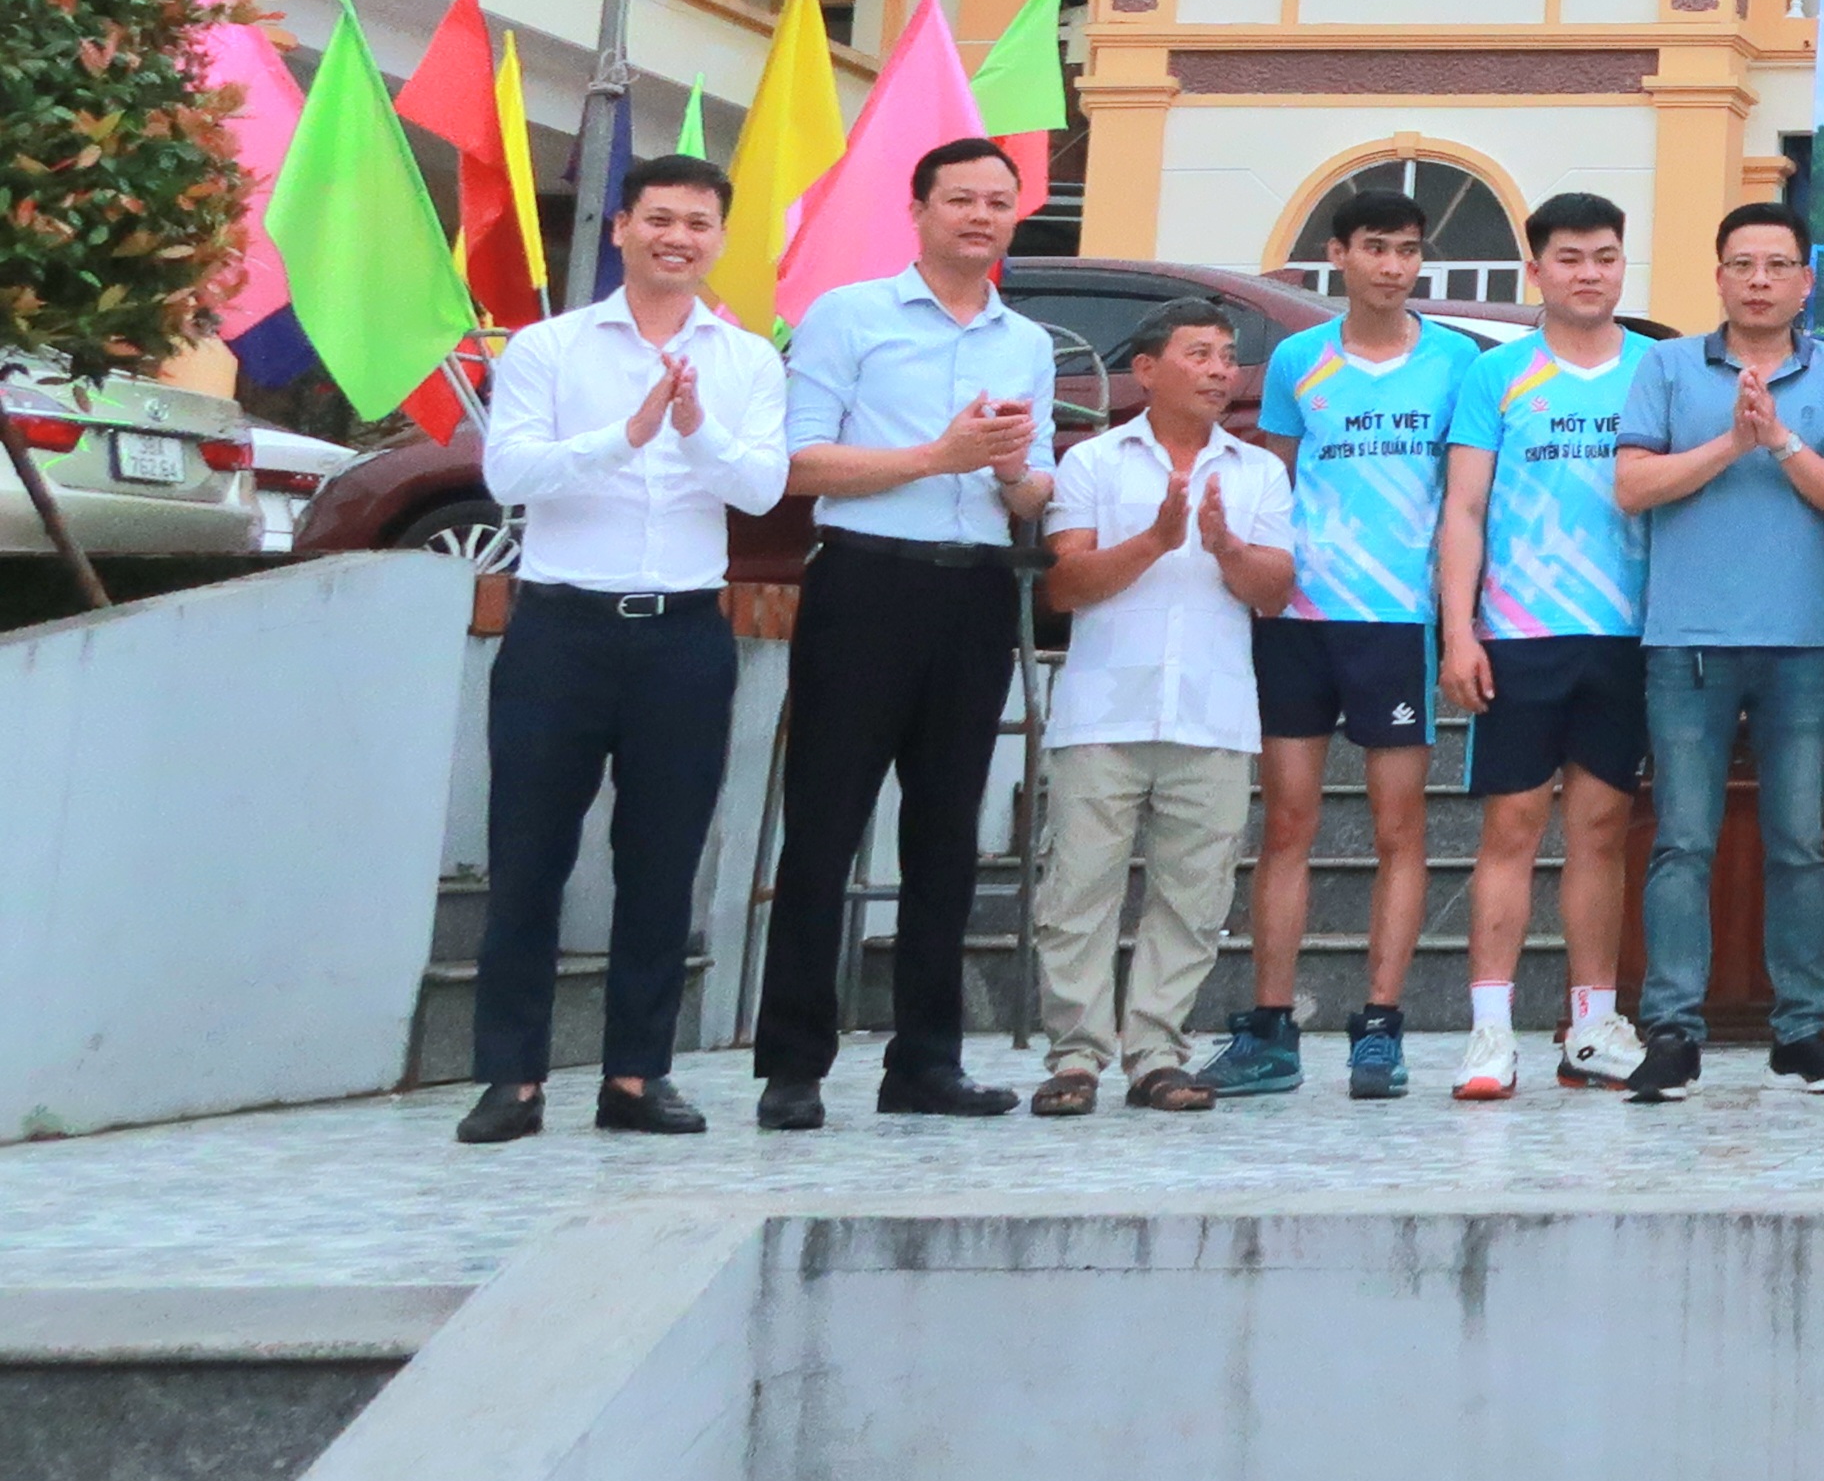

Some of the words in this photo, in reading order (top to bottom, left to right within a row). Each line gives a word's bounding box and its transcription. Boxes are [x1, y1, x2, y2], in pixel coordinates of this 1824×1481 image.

[1345, 408, 1384, 432] MỐT
[1391, 409, 1431, 434] VIỆT
[1550, 412, 1586, 433] MỐT
[1593, 412, 1621, 435] VIỆ
